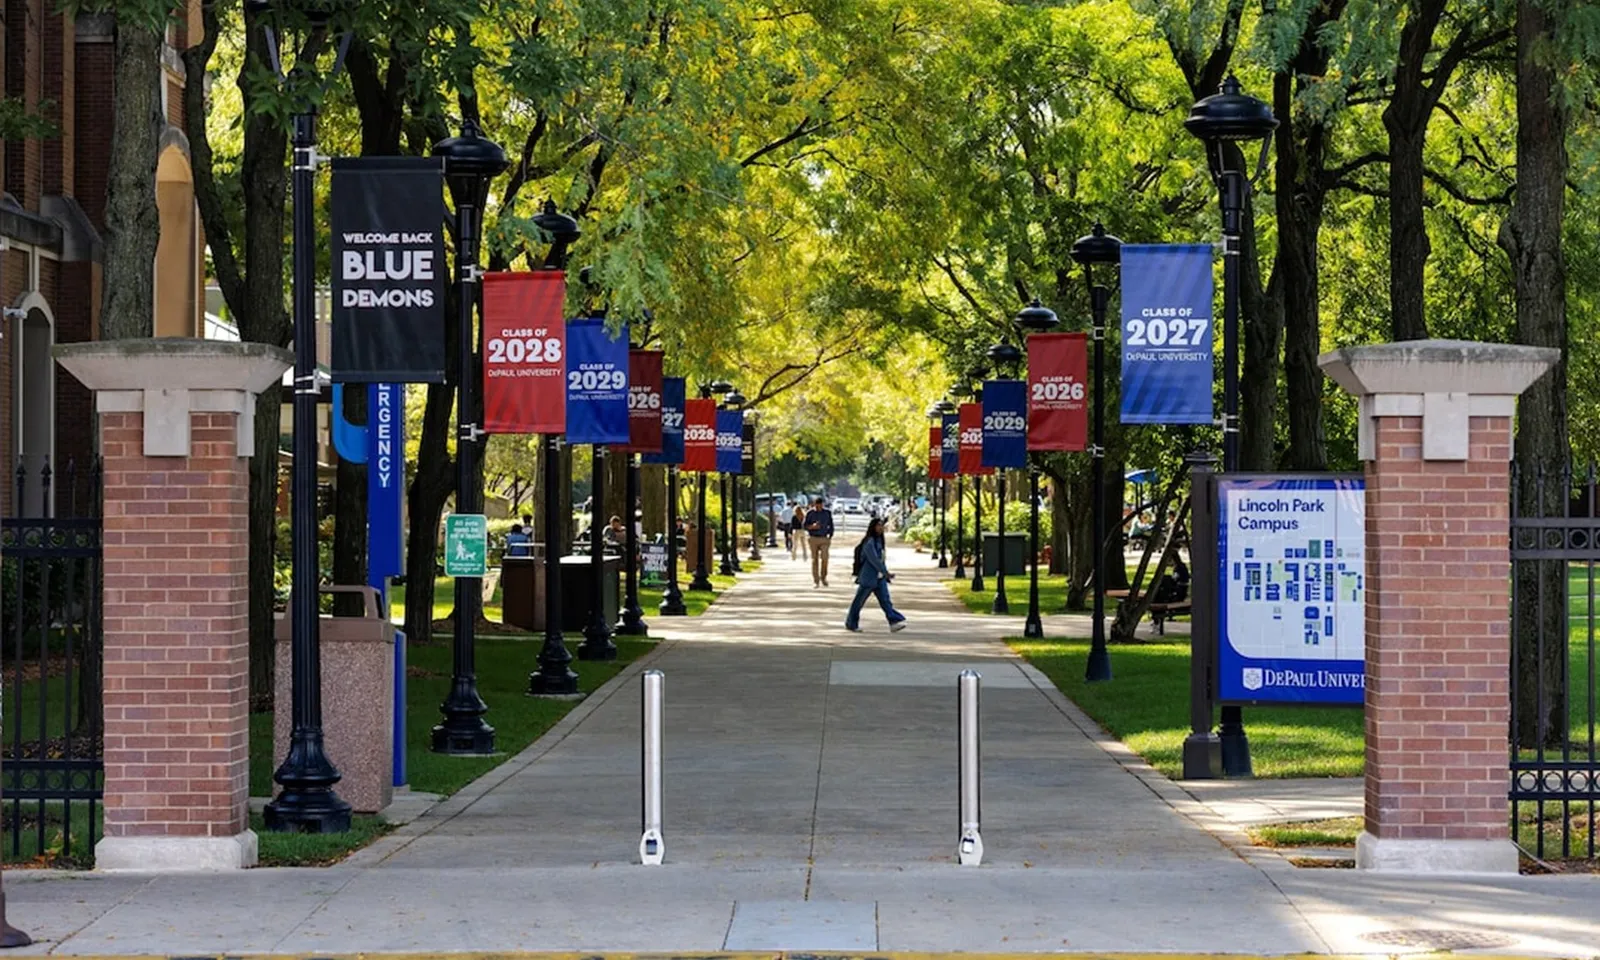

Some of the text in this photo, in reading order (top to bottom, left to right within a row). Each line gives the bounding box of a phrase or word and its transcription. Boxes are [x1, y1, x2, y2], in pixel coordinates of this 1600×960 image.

[343, 233, 433, 244] WELCOME BACK
[343, 250, 434, 281] BLUE
[343, 289, 434, 308] DEMONS
[1142, 309, 1193, 317] CLASS OF
[502, 329, 547, 337] CLASS OF
[1127, 319, 1208, 346] 2027
[488, 338, 562, 363] 2028
[1158, 352, 1208, 361] UNIVERSITY
[517, 368, 562, 377] UNIVERSITY
[568, 371, 626, 391] 2029
[1032, 383, 1084, 400] 2026
[628, 393, 661, 409] 026
[661, 413, 684, 427] 27
[984, 416, 1025, 430] 2029
[378, 383, 391, 488] RGENCY
[684, 429, 715, 441] 2028
[961, 432, 983, 444] 20
[943, 438, 957, 448] 20
[930, 448, 942, 457] 20
[1238, 498, 1325, 512] Lincoln Park
[1238, 516, 1299, 533] Campus
[1317, 670, 1365, 688] UNIVE
